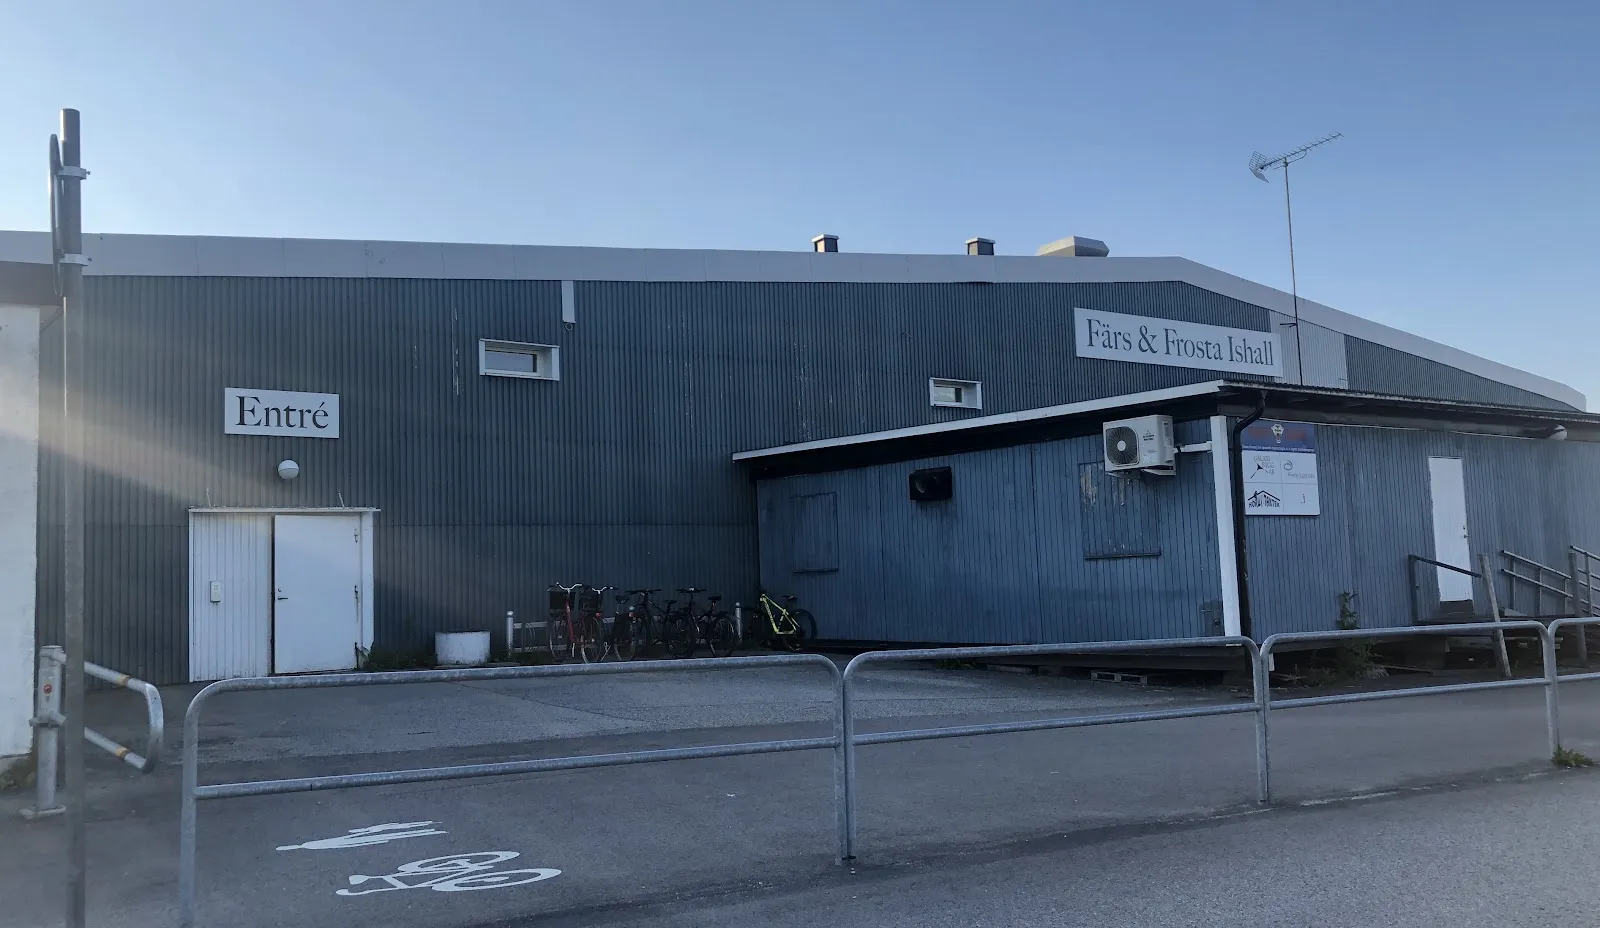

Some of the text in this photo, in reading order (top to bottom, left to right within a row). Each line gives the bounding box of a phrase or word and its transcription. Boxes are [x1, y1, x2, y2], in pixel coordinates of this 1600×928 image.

[1086, 318, 1274, 366] Färs & Frosta Ishall
[235, 395, 329, 429] Entré
